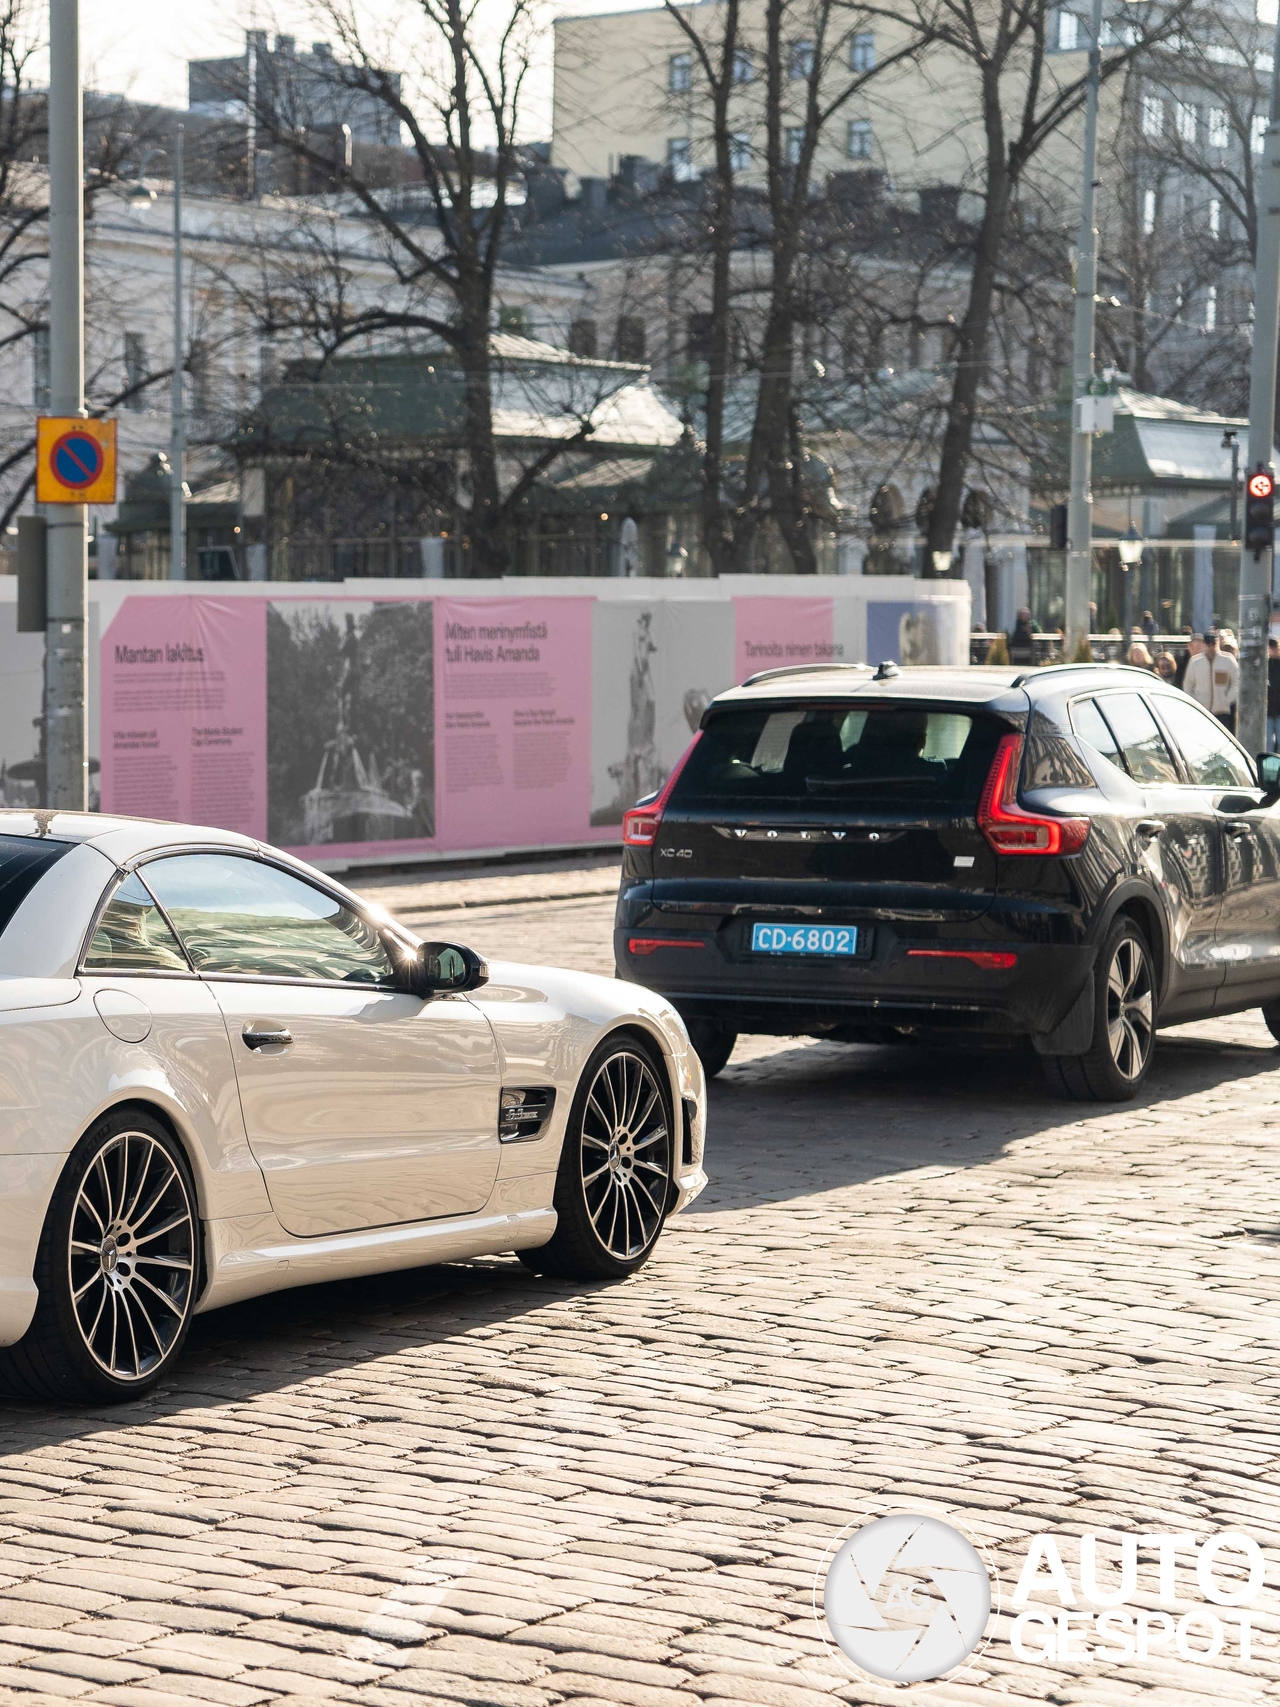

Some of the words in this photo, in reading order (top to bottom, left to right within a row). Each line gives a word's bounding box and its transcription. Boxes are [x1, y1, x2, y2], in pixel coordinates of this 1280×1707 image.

[445, 621, 476, 640] Miten
[478, 621, 548, 643] merinymfistä
[114, 645, 163, 663] Mantan
[165, 642, 204, 662] lakitus
[445, 644, 462, 662] tuli
[464, 644, 494, 662] Havis
[497, 643, 540, 662] Amanda
[734, 829, 880, 841] VOLVO
